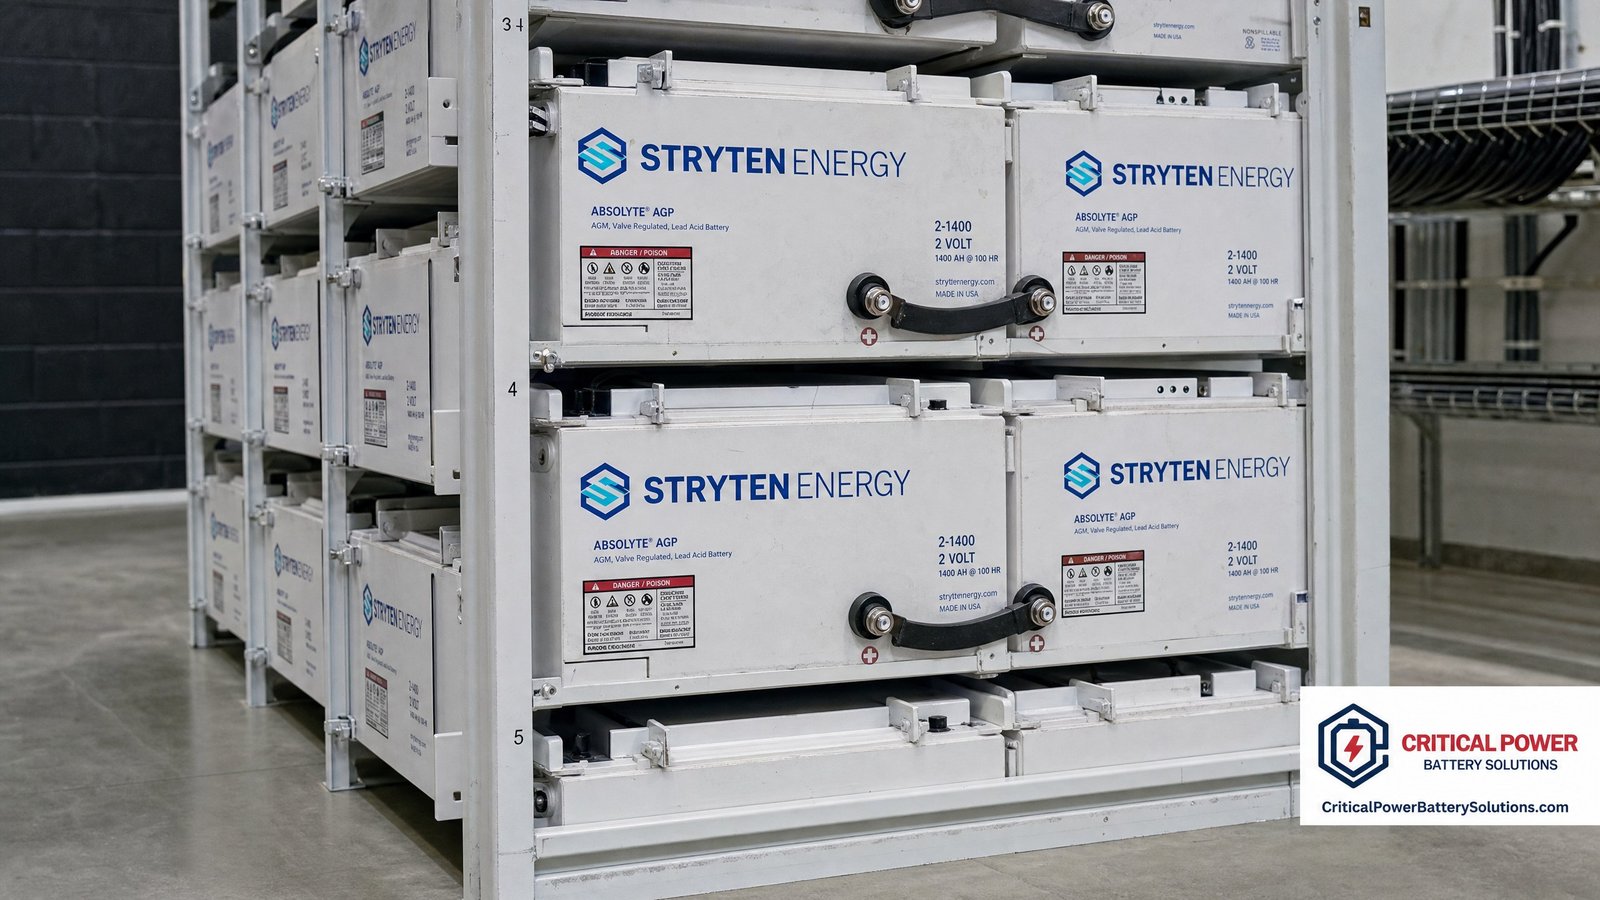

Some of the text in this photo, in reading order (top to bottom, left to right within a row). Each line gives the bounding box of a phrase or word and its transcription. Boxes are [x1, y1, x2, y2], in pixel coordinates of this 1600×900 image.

[369, 21, 416, 63] STRYTEN ENERGY
[640, 143, 907, 178] STRYTEN ENERGY
[1112, 164, 1294, 188] STRYTEN ENERGY
[652, 208, 674, 218] AGP
[1122, 212, 1138, 222] AGP
[591, 222, 611, 230] AGM,
[634, 222, 670, 232] Regulated,
[706, 224, 730, 232] Battery
[935, 220, 972, 232] 2-1400
[935, 238, 972, 250] 2 VOLT
[1228, 250, 1258, 260] 2-1400
[1228, 264, 1258, 274] 2 VOLT
[372, 314, 420, 335] STRYTEN ENERGY
[508, 381, 517, 396] 4
[1110, 456, 1291, 484] STRYTEN ENERGY
[643, 470, 910, 504] STRYTEN ENERGY
[1120, 512, 1136, 521] AGP
[656, 537, 678, 548] AGP
[938, 534, 975, 547] 2-1400
[1228, 540, 1258, 551] 2-1400
[636, 554, 673, 562] Regulated,
[708, 550, 732, 558] Battery
[939, 552, 975, 564] 2 VOLT
[1228, 555, 1258, 566] 2 VOLT
[939, 569, 955, 577] 1400
[612, 581, 640, 589] DANGER
[374, 598, 423, 639] STRYTEN ENERGY
[514, 729, 524, 745] 5
